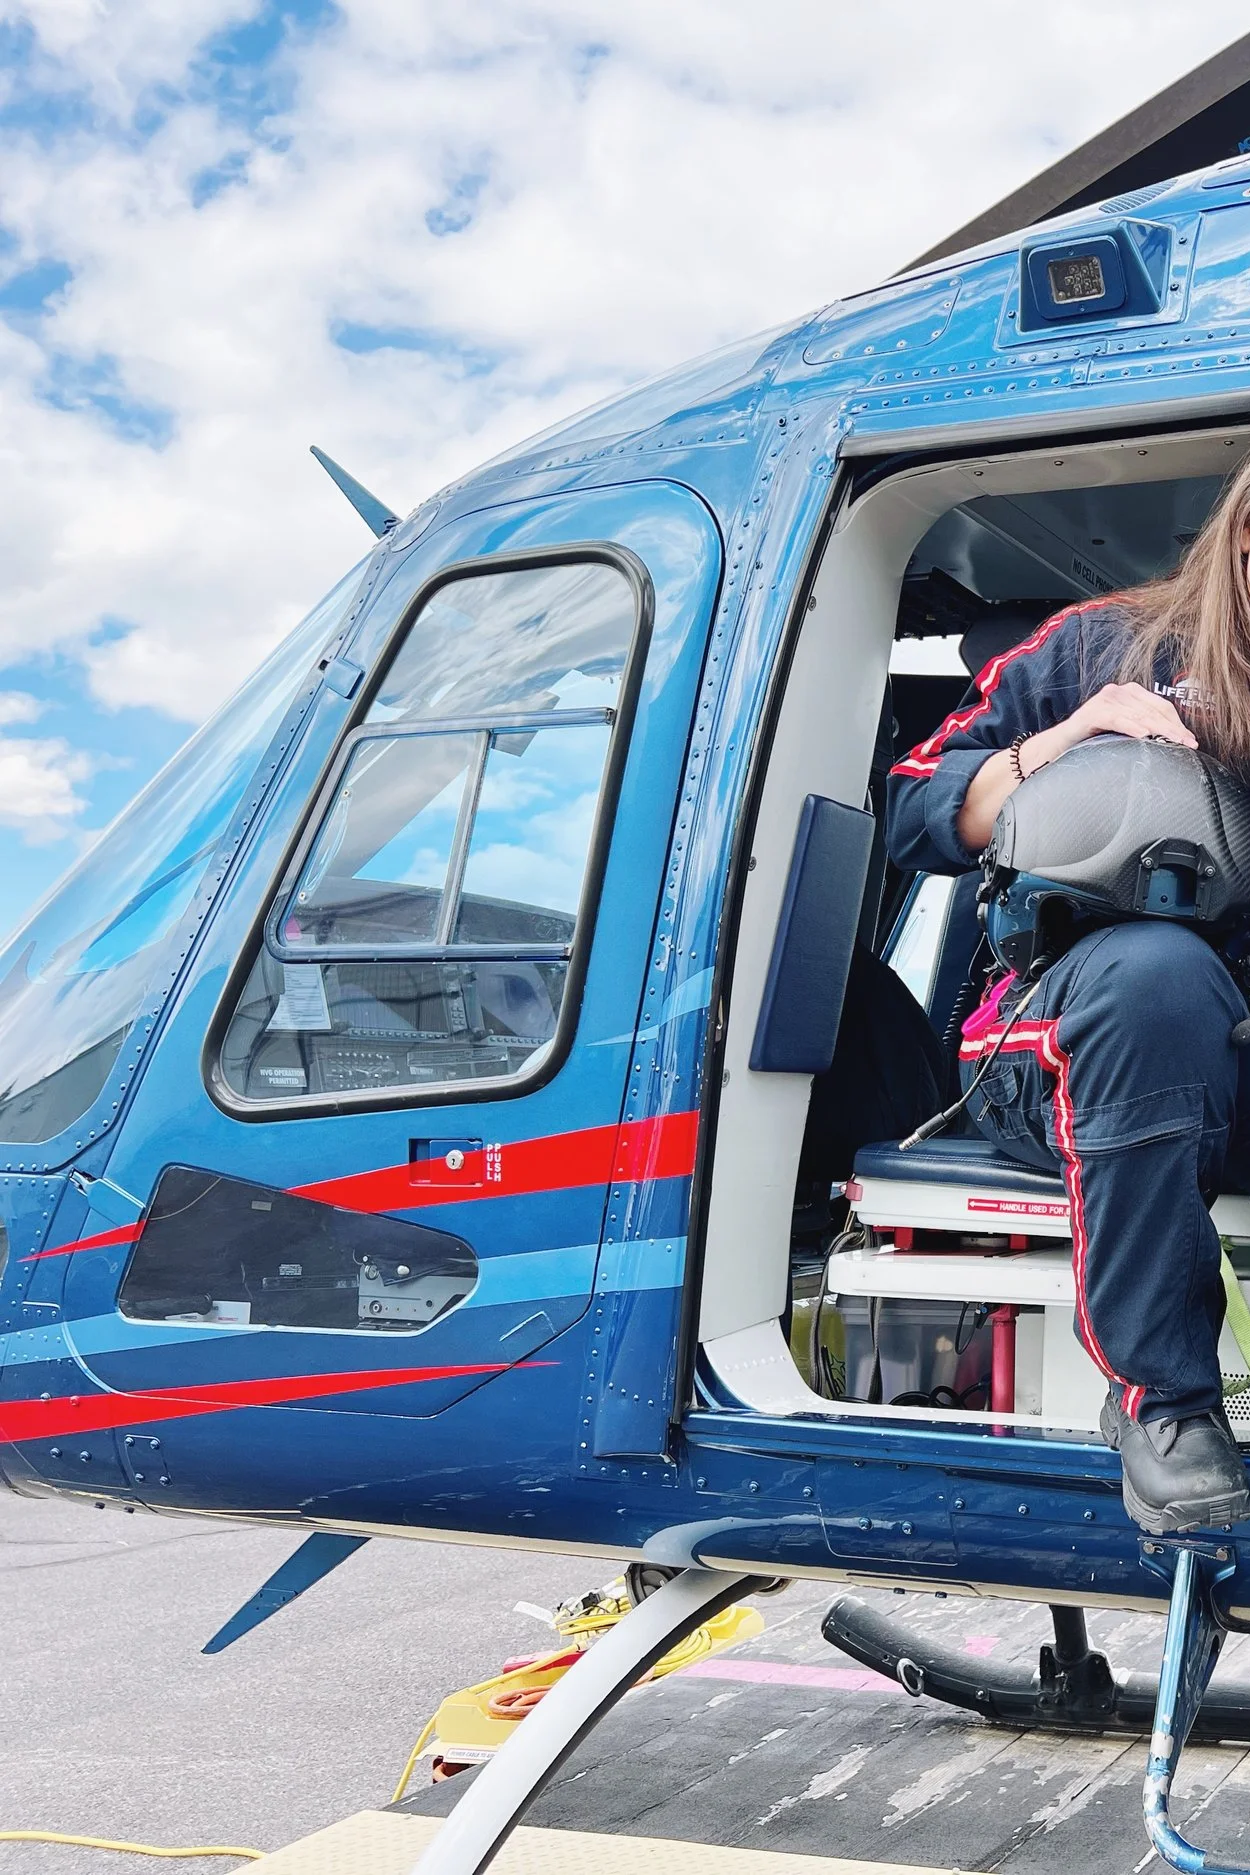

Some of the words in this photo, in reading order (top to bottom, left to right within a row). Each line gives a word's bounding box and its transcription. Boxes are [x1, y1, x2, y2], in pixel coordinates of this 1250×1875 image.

[1072, 558, 1082, 575] NO
[1081, 565, 1096, 585] CELL
[1154, 682, 1186, 699] LIFE
[494, 1143, 502, 1182] PUSH
[999, 1202, 1027, 1212] HANDLE
[1028, 1204, 1048, 1214] USED
[1049, 1206, 1065, 1215] FOR
